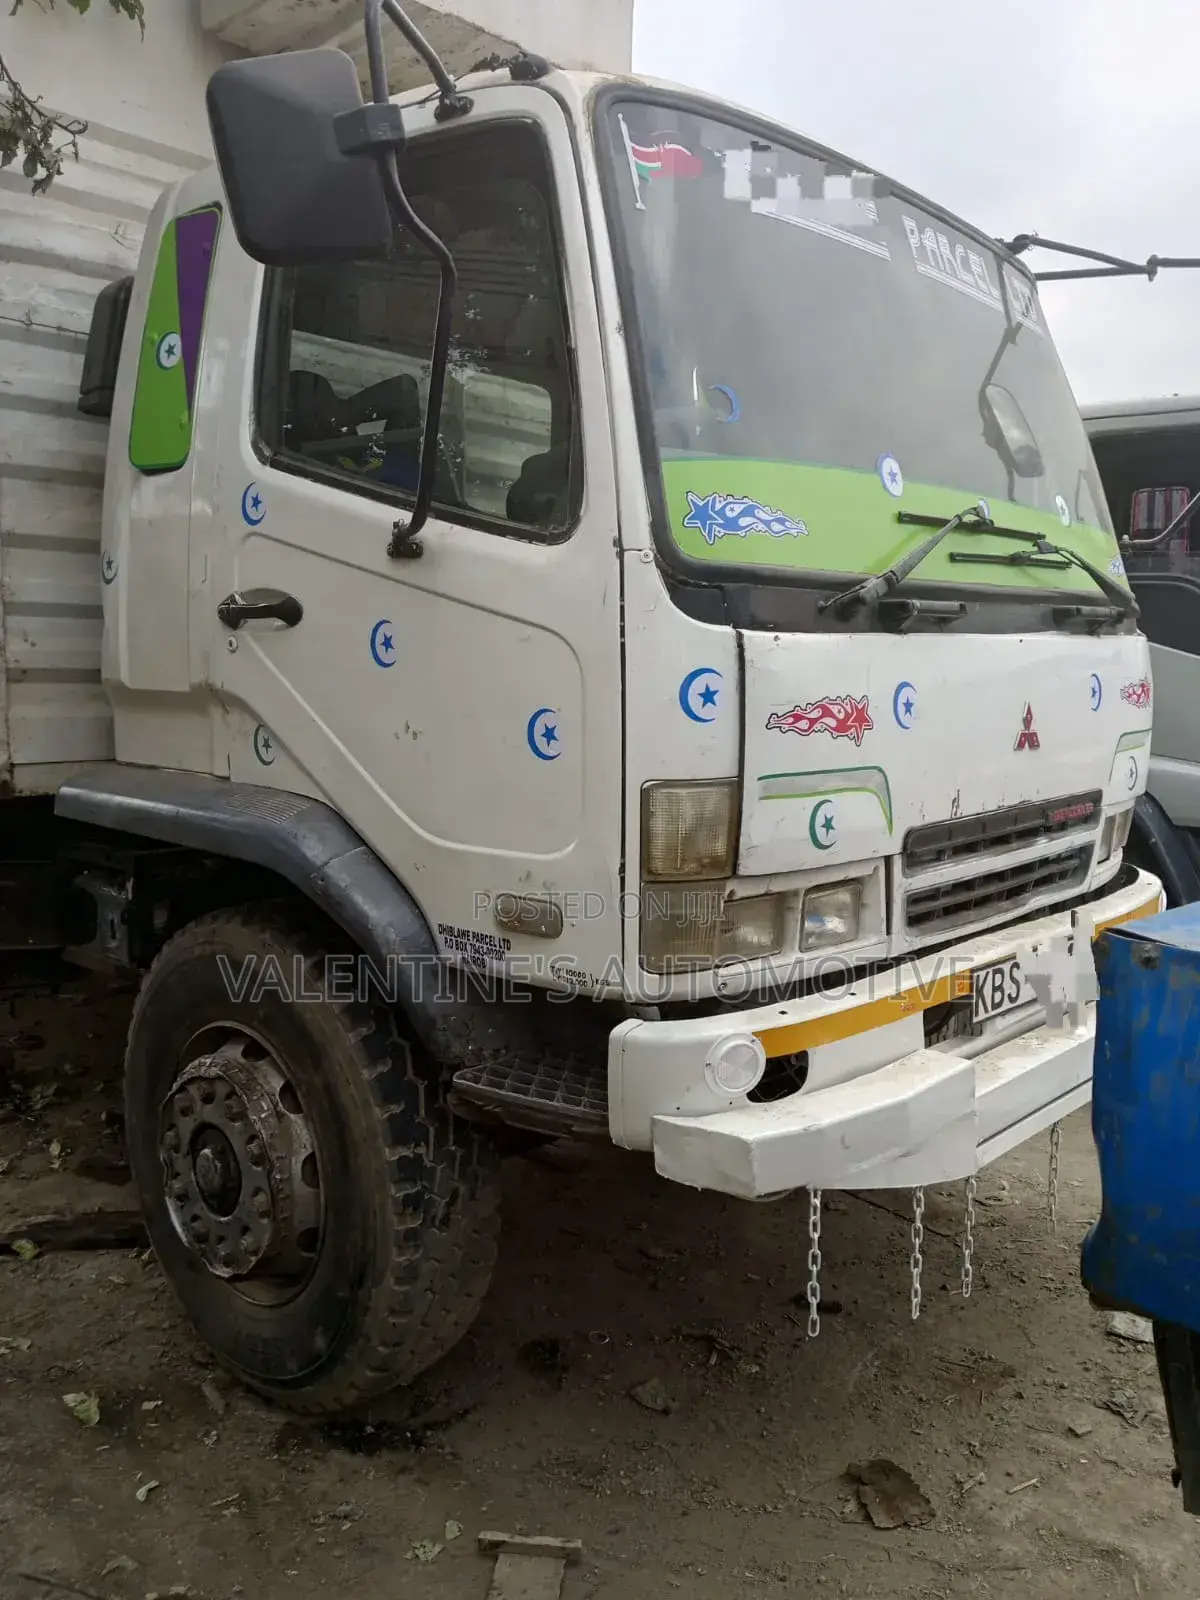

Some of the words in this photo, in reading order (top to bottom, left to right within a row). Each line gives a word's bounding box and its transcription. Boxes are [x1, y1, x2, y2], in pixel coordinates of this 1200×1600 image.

[901, 214, 1002, 300] PARCEL
[438, 923, 471, 942] DHIBLAWE
[471, 931, 497, 949] PARCEL
[498, 937, 512, 951] LTD
[455, 939, 469, 953] BOX
[974, 961, 1020, 1018] KBS
